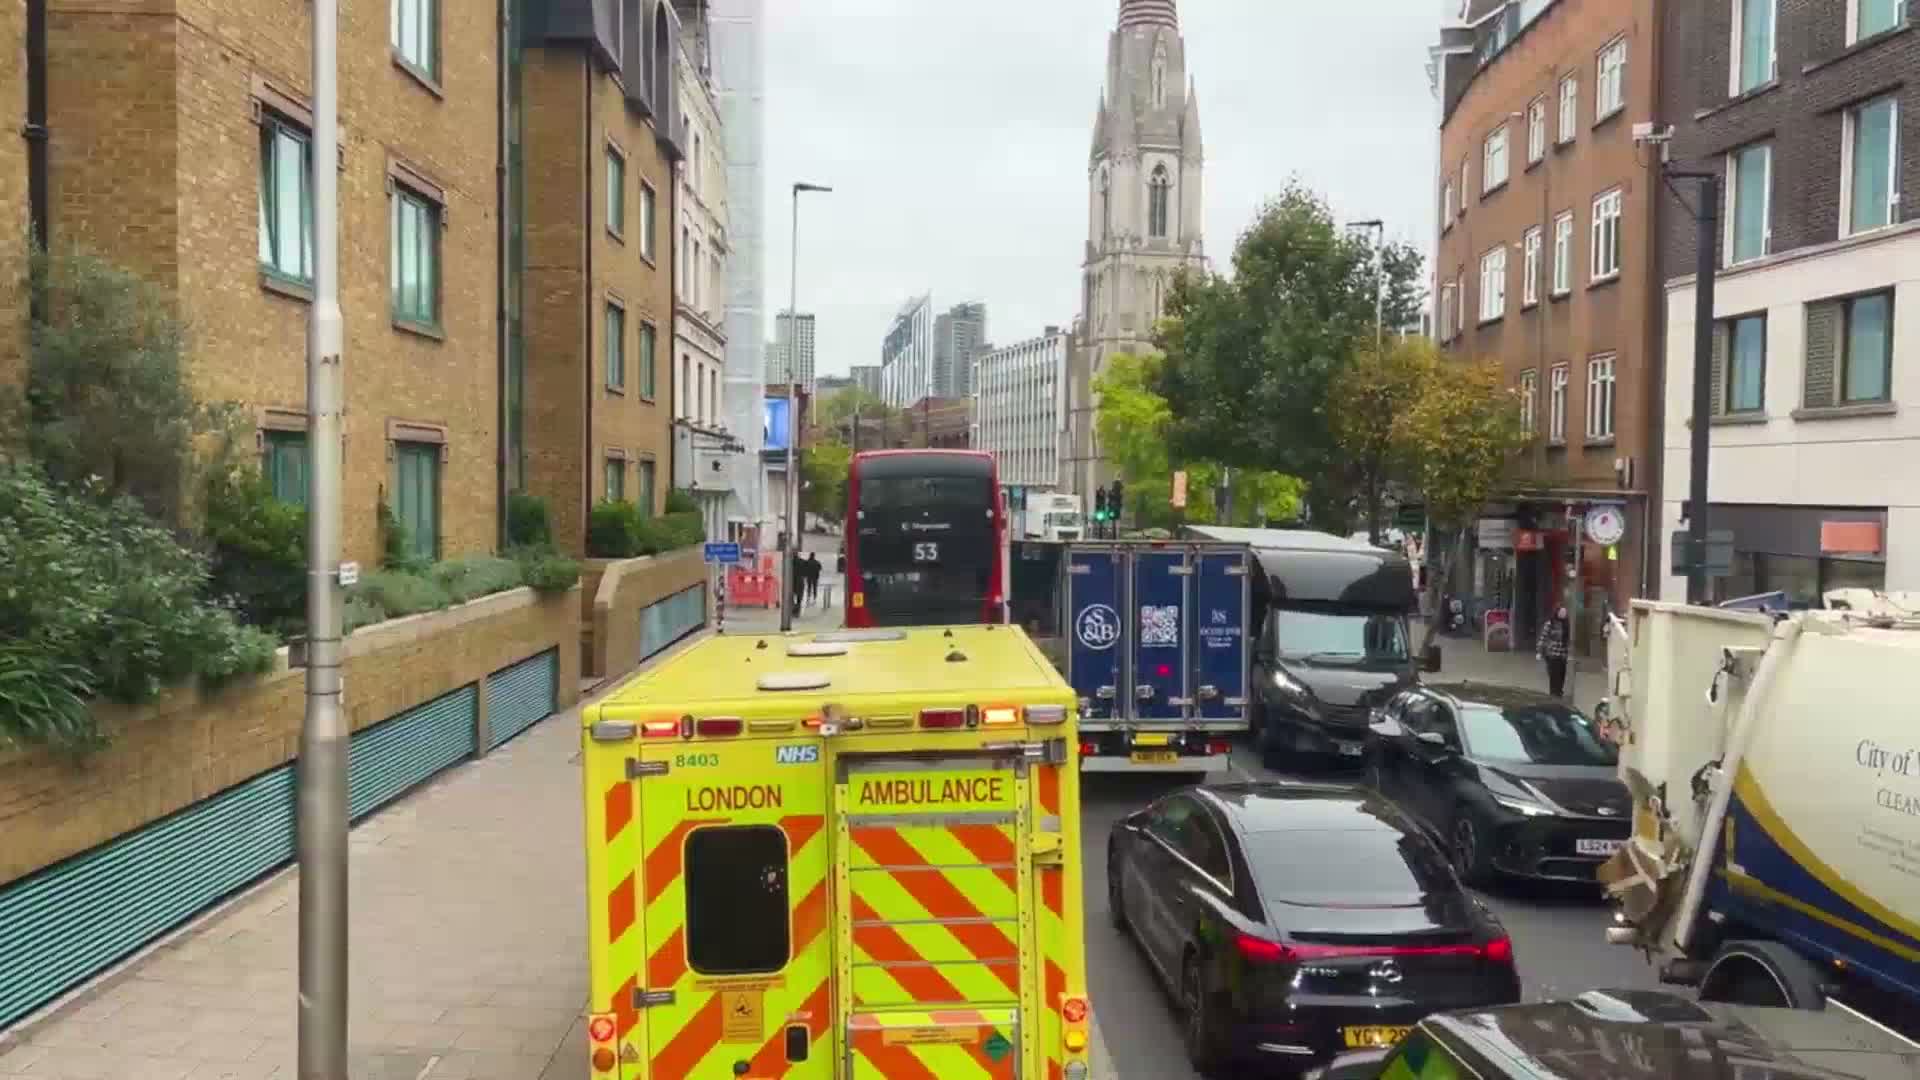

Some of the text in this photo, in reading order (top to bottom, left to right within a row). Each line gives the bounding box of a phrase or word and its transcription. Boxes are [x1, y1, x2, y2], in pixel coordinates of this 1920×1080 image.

[915, 542, 937, 560] 53
[675, 754, 719, 767] 8403
[777, 745, 817, 763] NHS
[1856, 739, 1914, 777] City of
[687, 784, 782, 812] LONDON
[860, 777, 1004, 804] AMBULANCE
